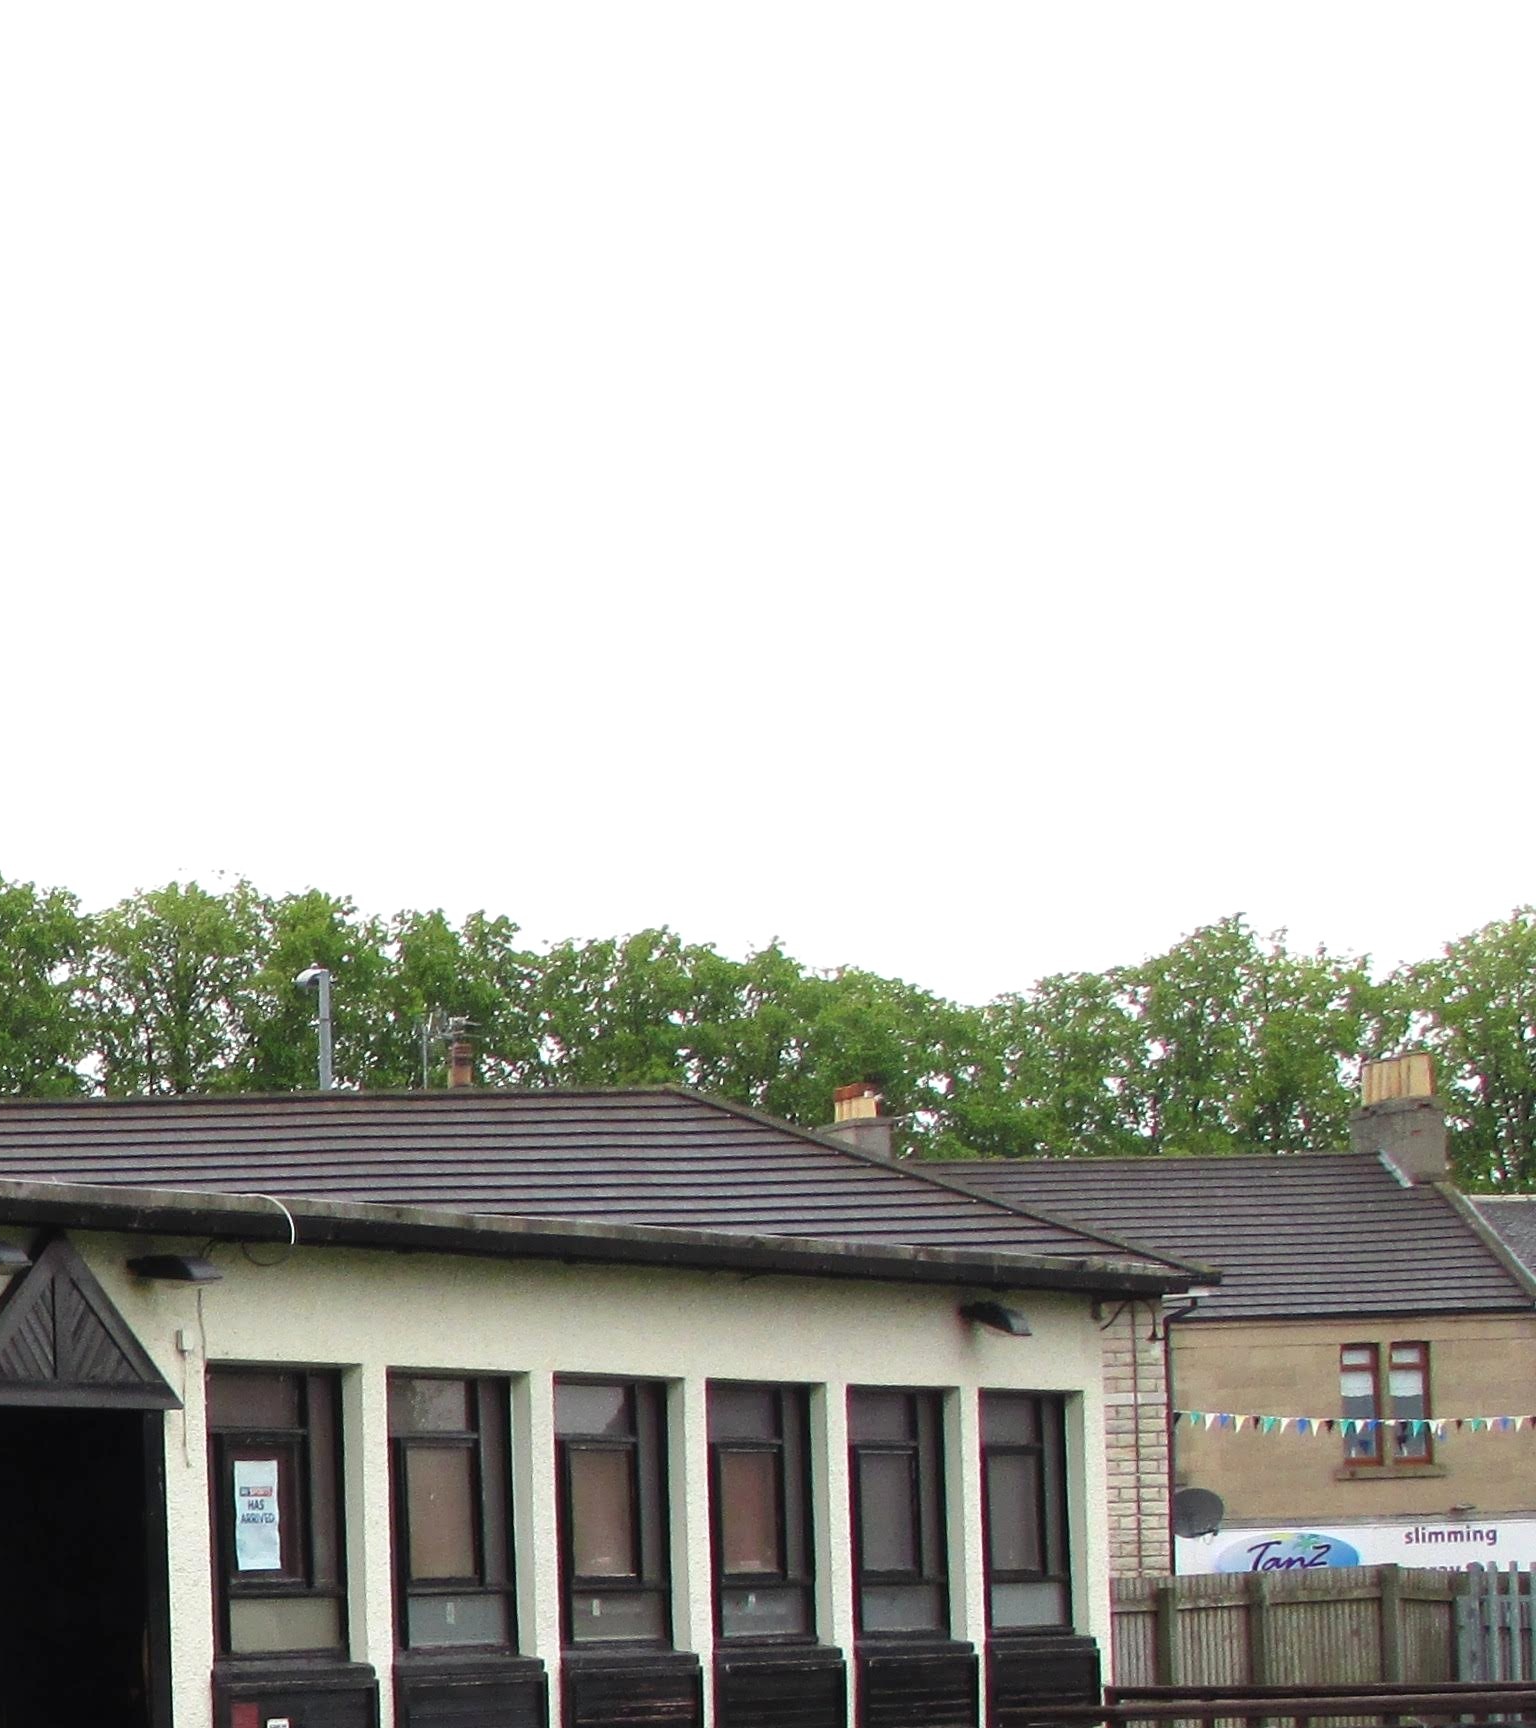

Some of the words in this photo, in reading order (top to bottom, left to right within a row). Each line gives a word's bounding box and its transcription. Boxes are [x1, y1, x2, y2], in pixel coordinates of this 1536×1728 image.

[248, 1499, 264, 1510] HAS
[241, 1512, 275, 1523] ARRIVED
[1405, 1526, 1497, 1545] slimming
